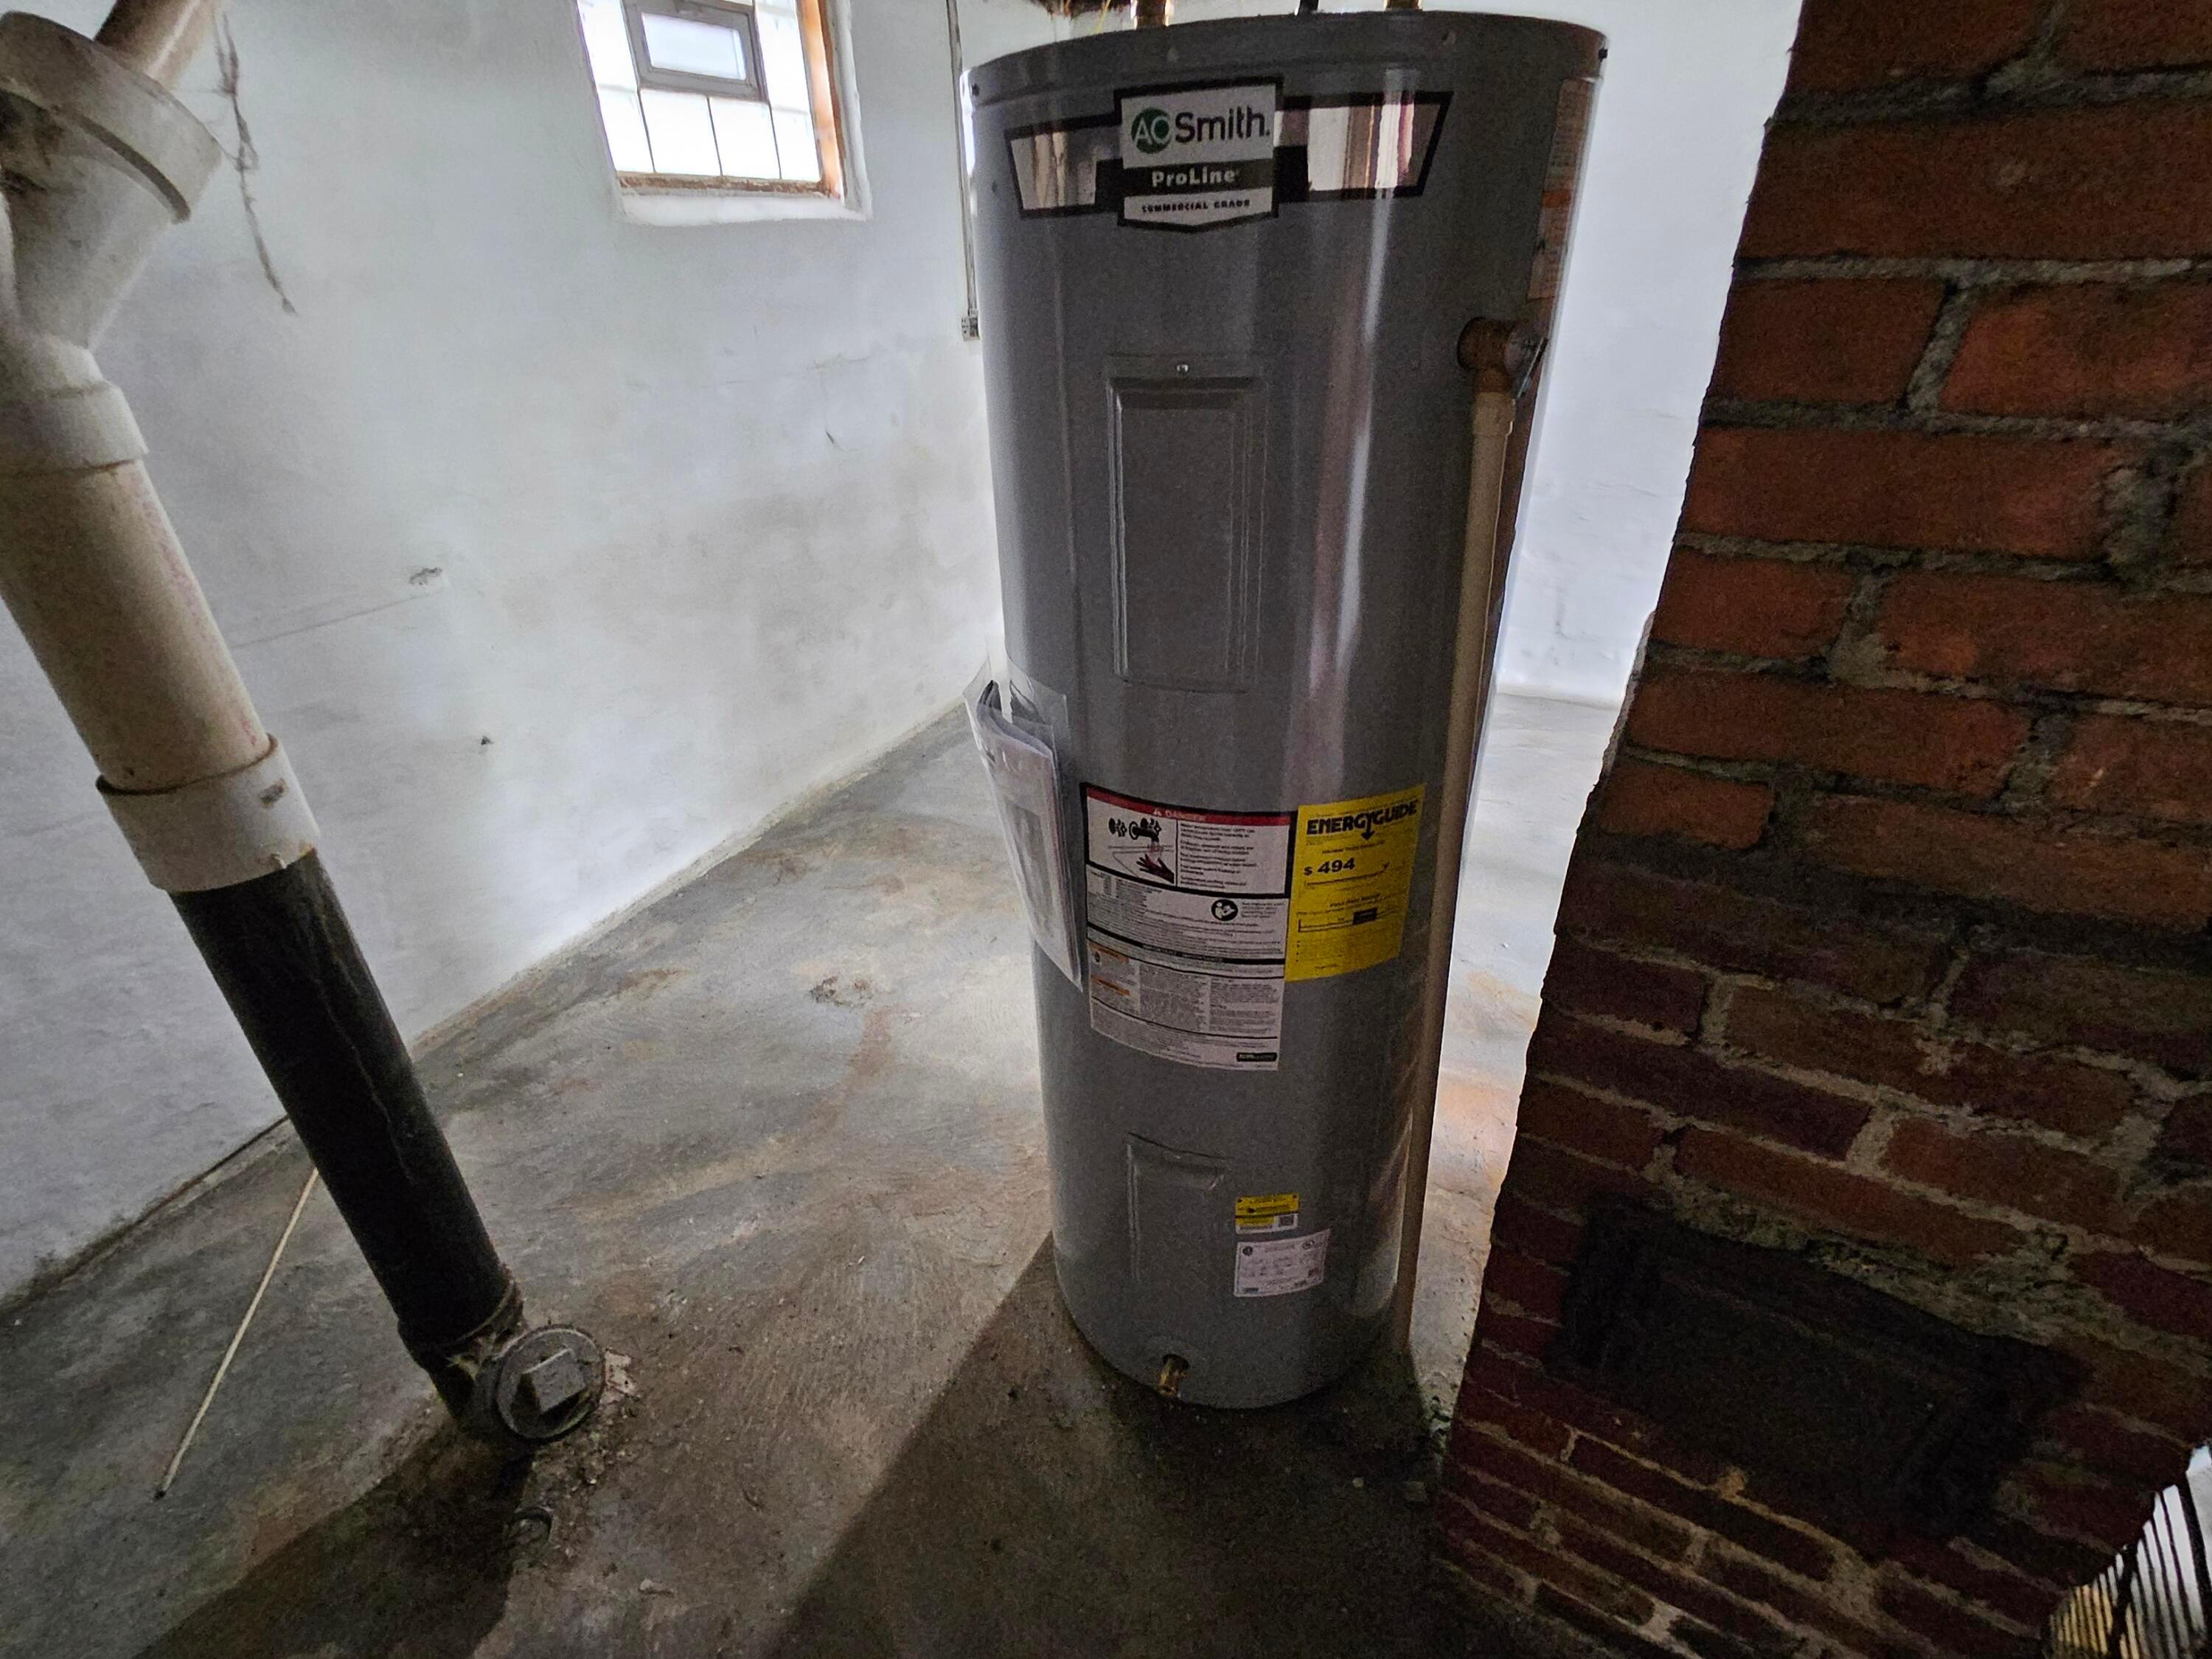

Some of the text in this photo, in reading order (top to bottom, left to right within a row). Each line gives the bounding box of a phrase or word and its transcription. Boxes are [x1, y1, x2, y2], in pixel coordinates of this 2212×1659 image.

[1151, 166, 1236, 187] ProLine
[1141, 198, 1251, 214] COMMERCIAL GRADE
[1317, 857, 1355, 874] 494
